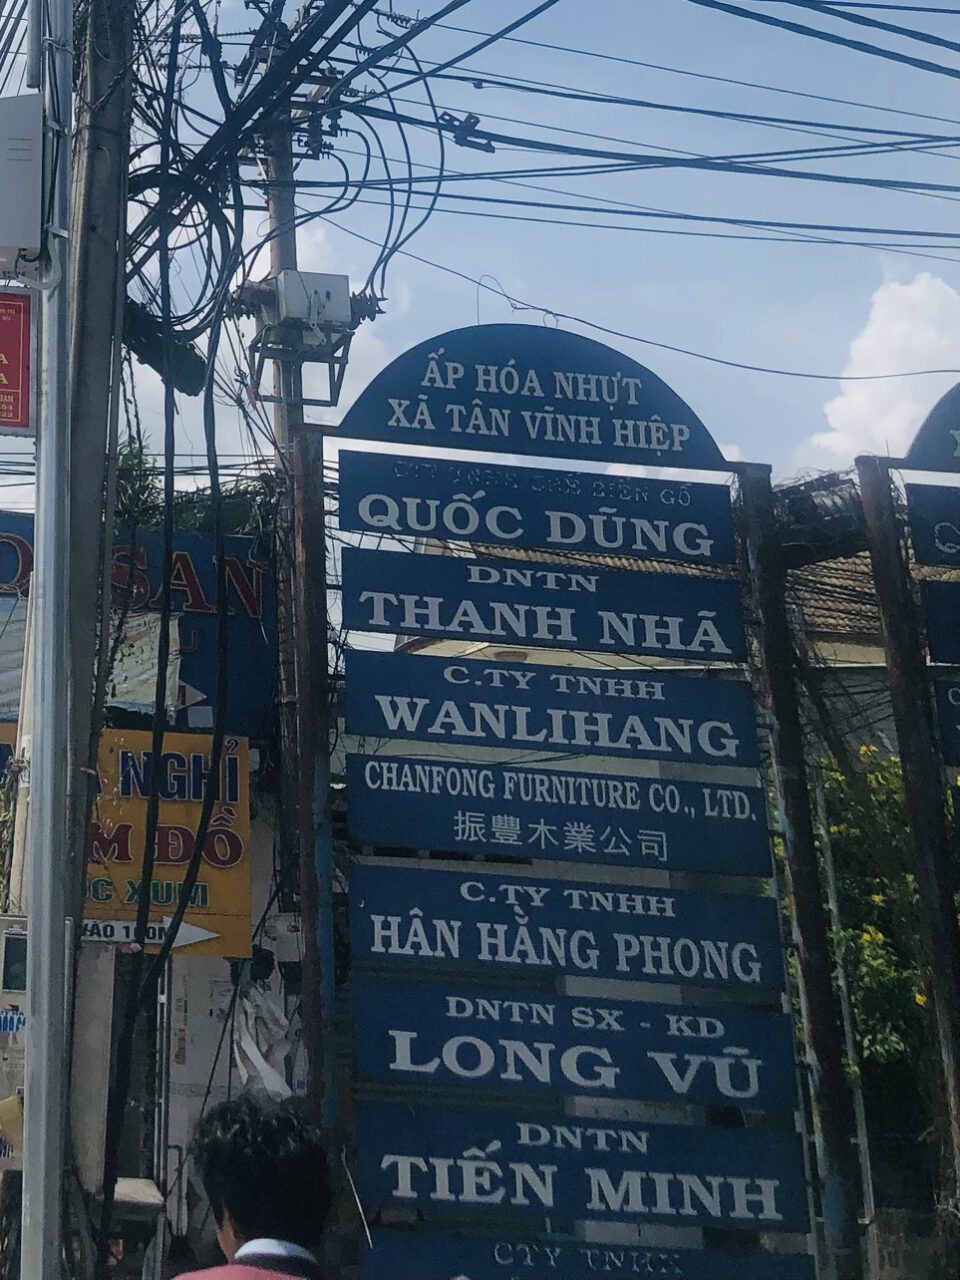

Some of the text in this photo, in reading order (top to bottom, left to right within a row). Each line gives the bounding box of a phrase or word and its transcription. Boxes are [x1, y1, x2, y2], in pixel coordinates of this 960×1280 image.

[421, 347, 642, 412] ẤP HÓA NHỰT
[387, 395, 691, 457] XÃ TÂN VĨNH HIỆP
[358, 489, 715, 556] QUỐC DŨNG
[467, 565, 600, 593] DNTN
[359, 590, 733, 654] THANH NHÃ
[443, 665, 666, 700] C.TY TNHH
[375, 694, 740, 758] WANLIHANG
[364, 760, 758, 821] CHANFONG FURNITURE CO., LTD.
[453, 809, 669, 863] 振豐木業公司
[459, 881, 676, 918] C.TY TNHH
[371, 905, 762, 983] HÂN HẰNG PHONG
[445, 996, 556, 1026] DNTN
[571, 1006, 626, 1032] SX
[666, 1013, 726, 1040] KD
[388, 1029, 763, 1099] LONG VŨ
[516, 1122, 650, 1154] DNTN
[381, 1139, 784, 1221] TIẾN MINH
[493, 1241, 561, 1268] CTY
